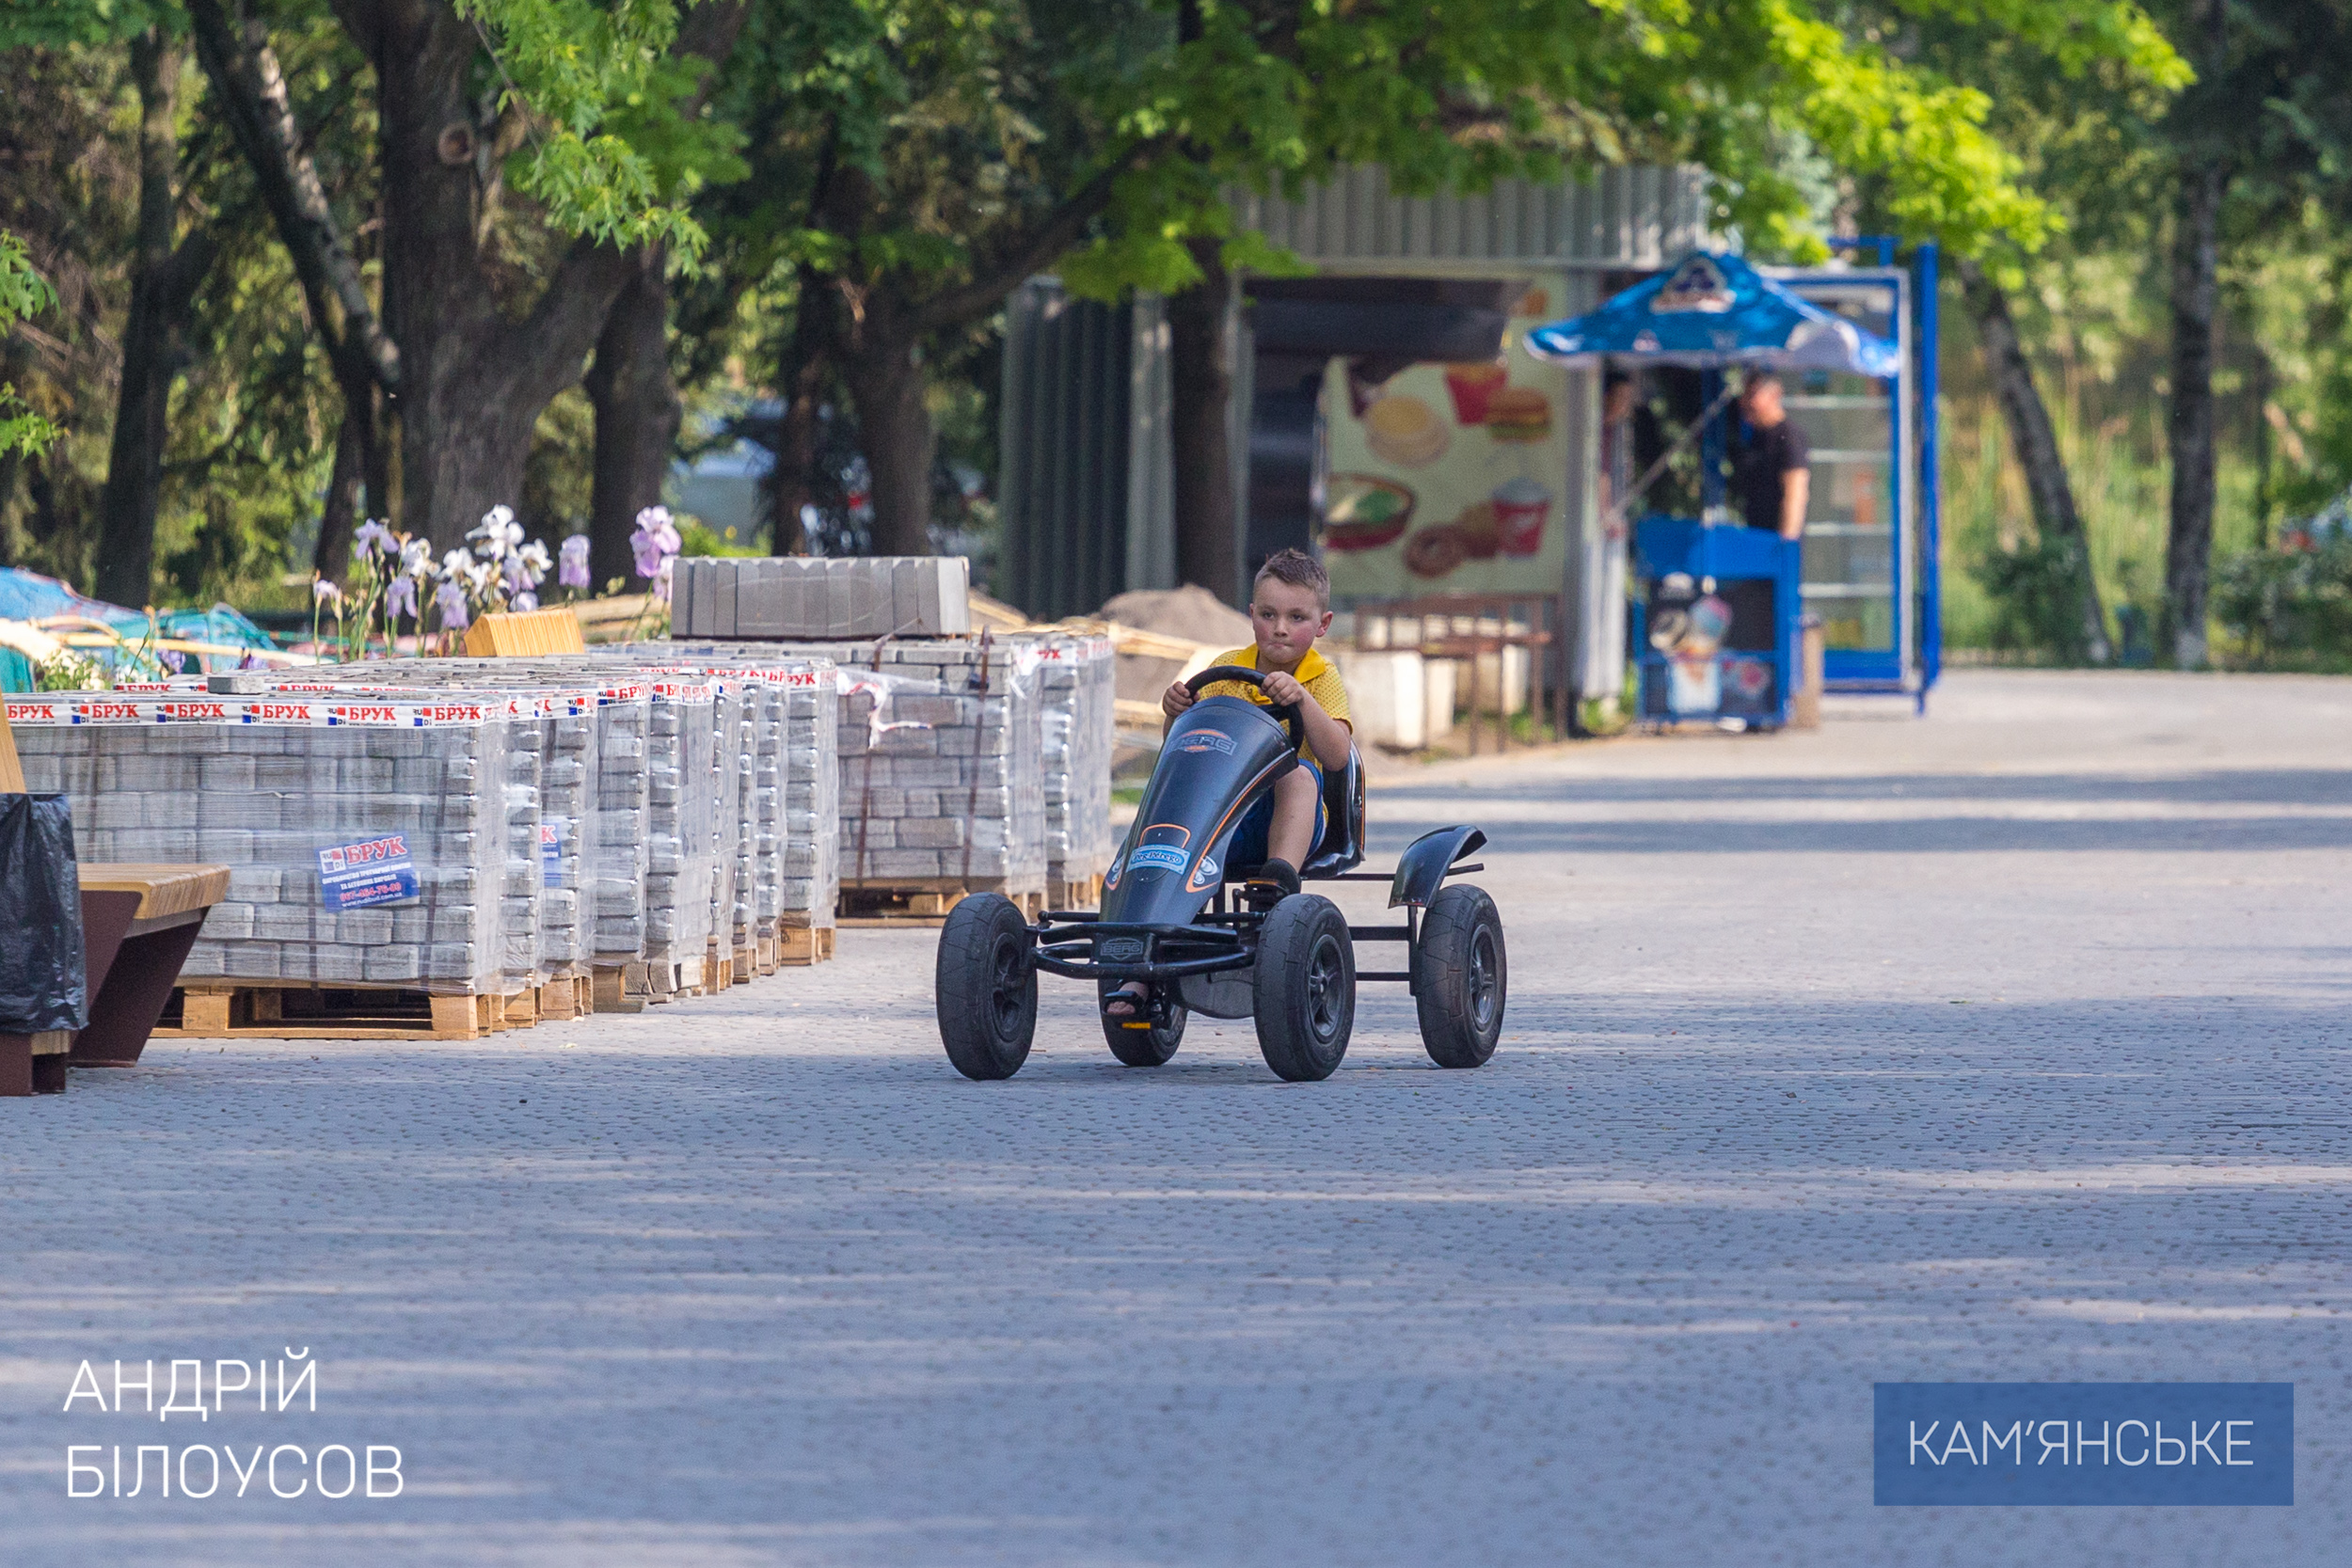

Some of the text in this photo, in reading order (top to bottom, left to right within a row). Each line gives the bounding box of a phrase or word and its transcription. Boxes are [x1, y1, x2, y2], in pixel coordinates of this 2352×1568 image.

[8, 705, 55, 719] БРУК
[91, 705, 140, 718] БРУК
[177, 704, 226, 718] БРУК
[262, 705, 310, 720] БРУК
[348, 706, 396, 721] БРУК
[434, 706, 481, 721] БРУК
[344, 836, 407, 864] БРУК
